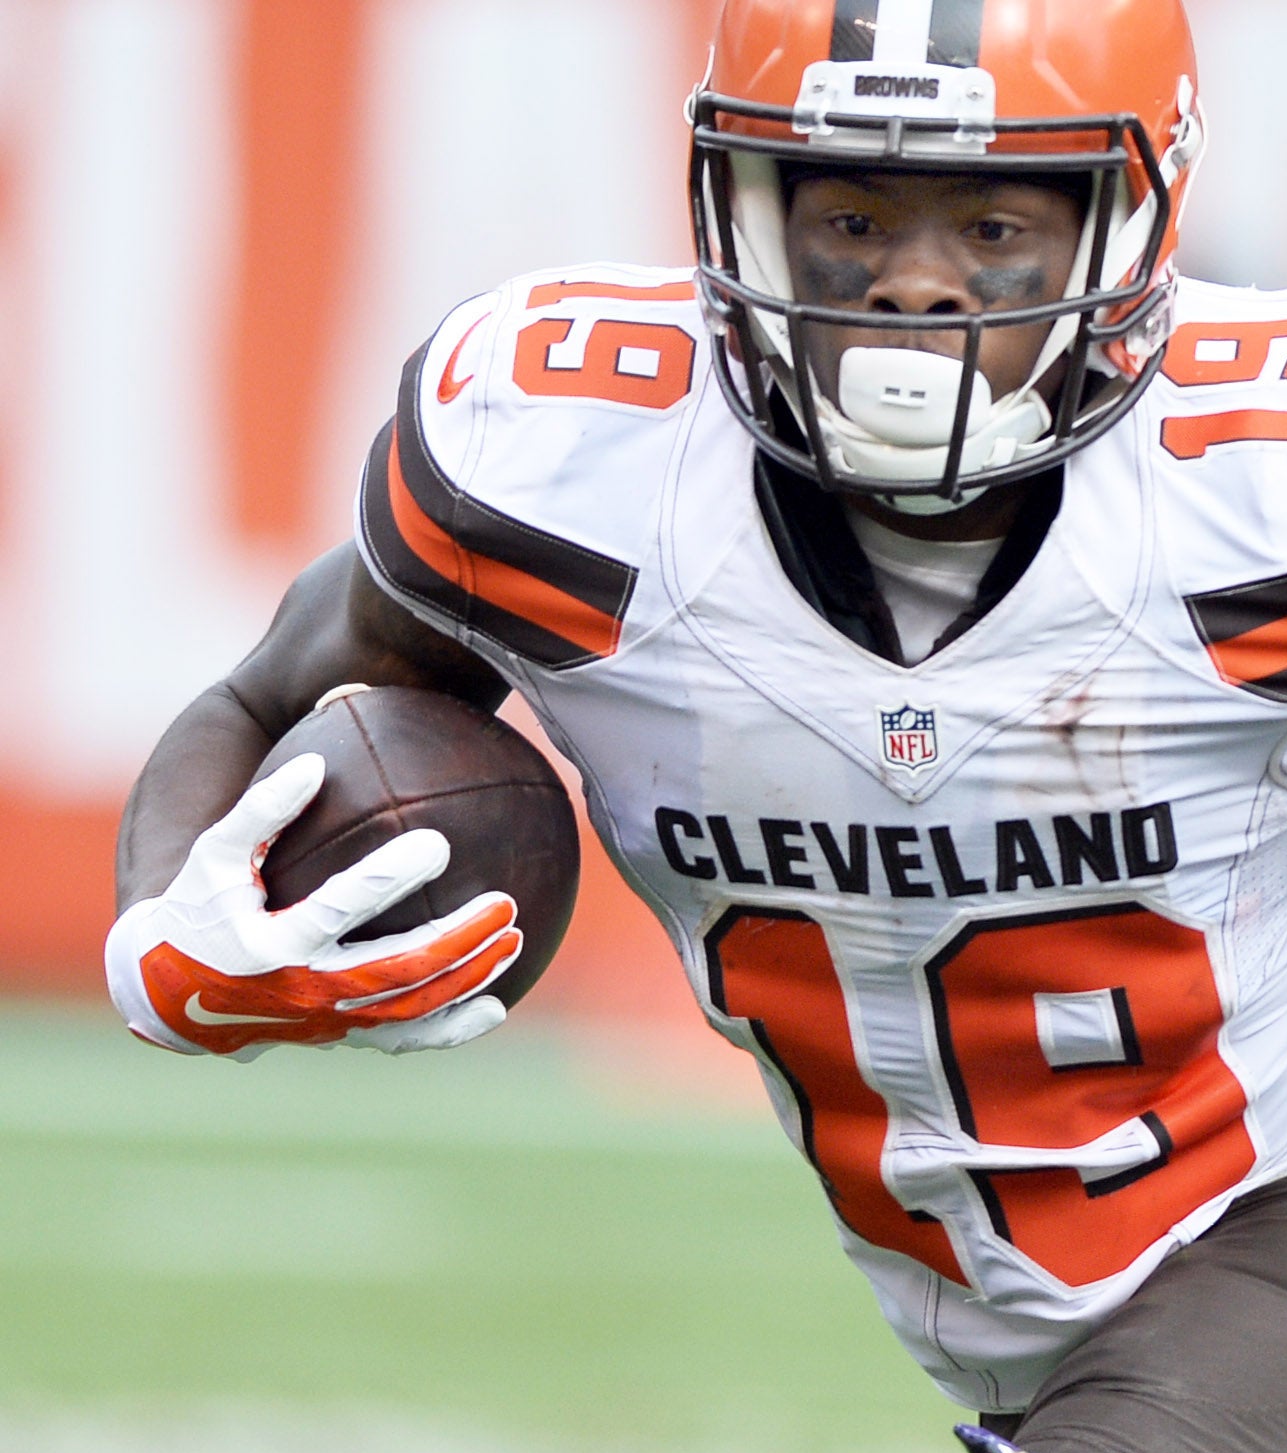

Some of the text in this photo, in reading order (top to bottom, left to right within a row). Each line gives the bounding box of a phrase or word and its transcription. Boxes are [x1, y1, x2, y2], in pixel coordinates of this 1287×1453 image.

[855, 75, 940, 99] BROWNS
[512, 281, 697, 410] 19
[888, 734, 933, 762] NFL
[654, 801, 1179, 898] CLEVELAND
[703, 900, 1258, 1290] 19
